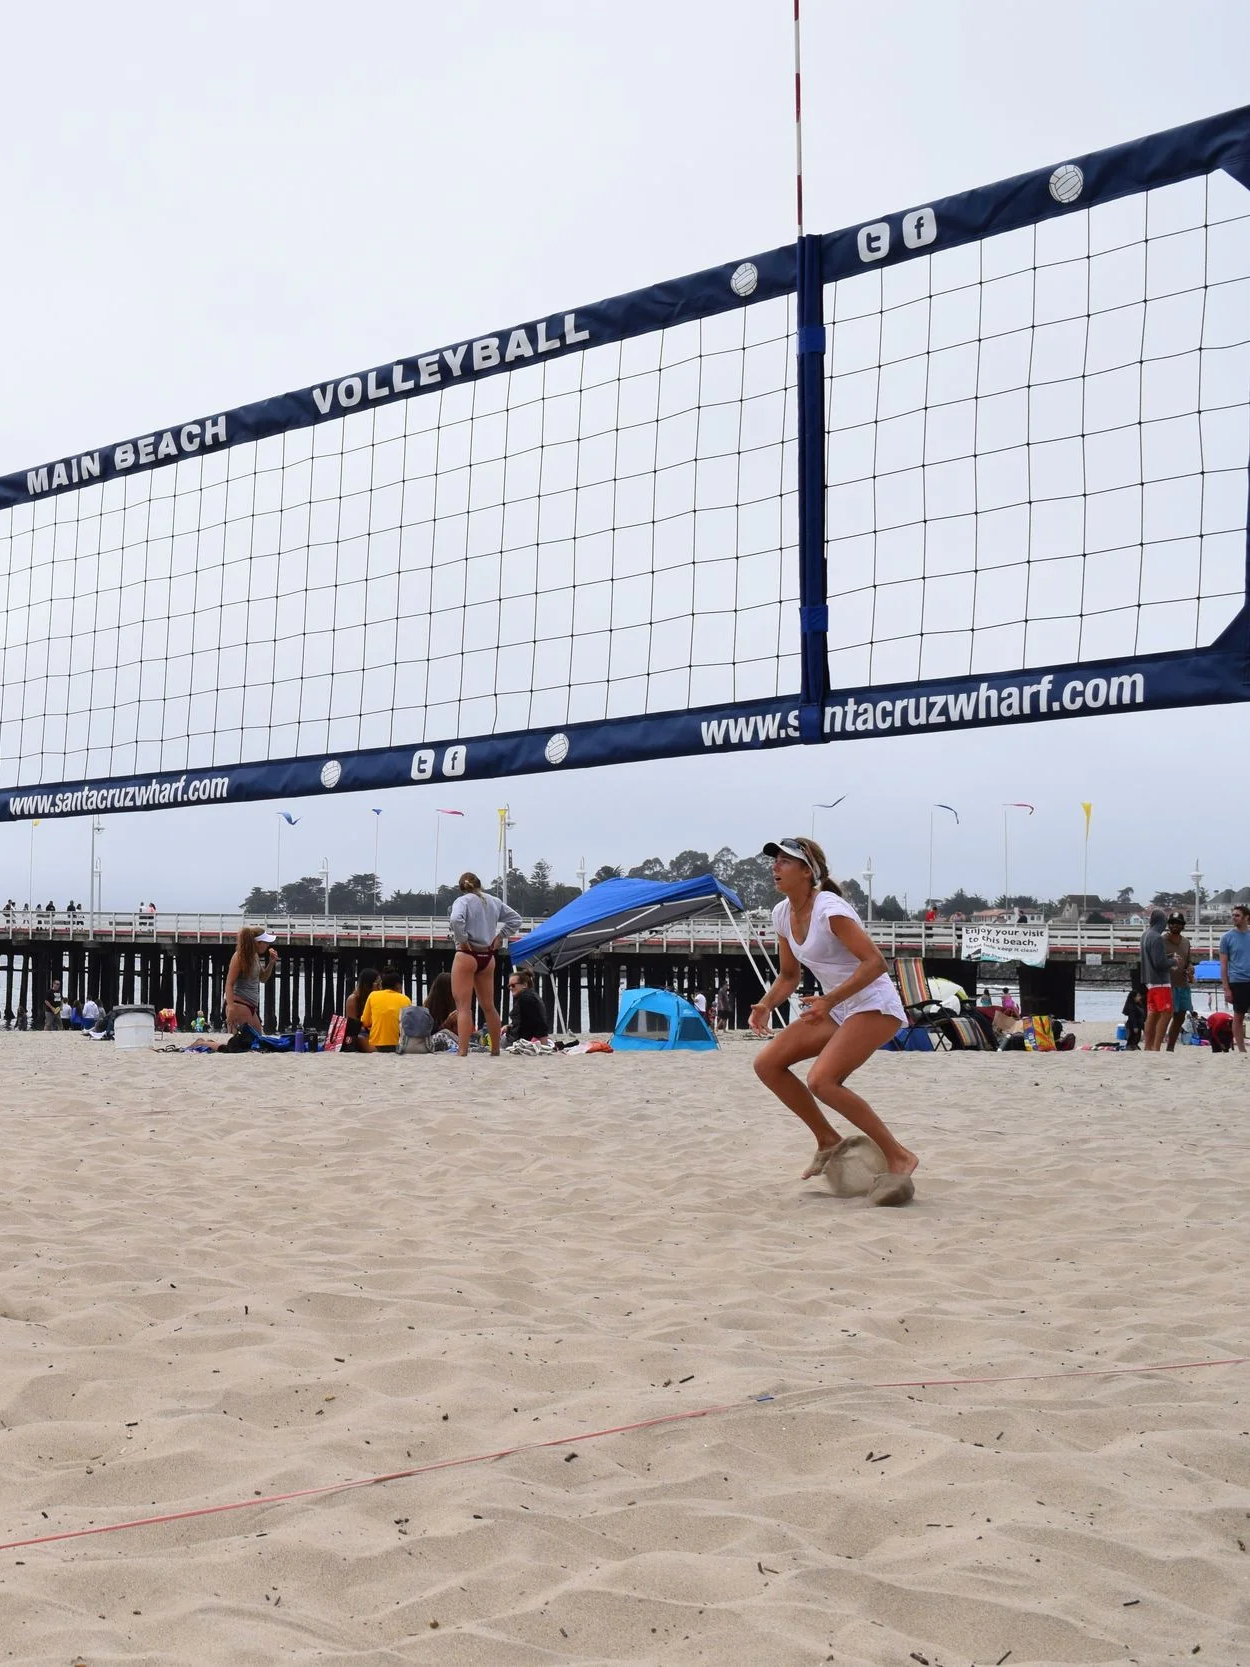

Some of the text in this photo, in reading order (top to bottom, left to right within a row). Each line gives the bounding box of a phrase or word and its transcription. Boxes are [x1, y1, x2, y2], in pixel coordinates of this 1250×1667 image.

[312, 313, 590, 415] VOLLEYBALL
[27, 416, 227, 496] MAIN BEACH
[701, 673, 1145, 746] www.sntacruzwharf.com
[10, 775, 229, 816] www.santacruzwharf.com
[981, 935, 1000, 945] this
[1003, 938, 1037, 947] beach,
[995, 928, 1019, 937] your
[1022, 929, 1044, 937] visit
